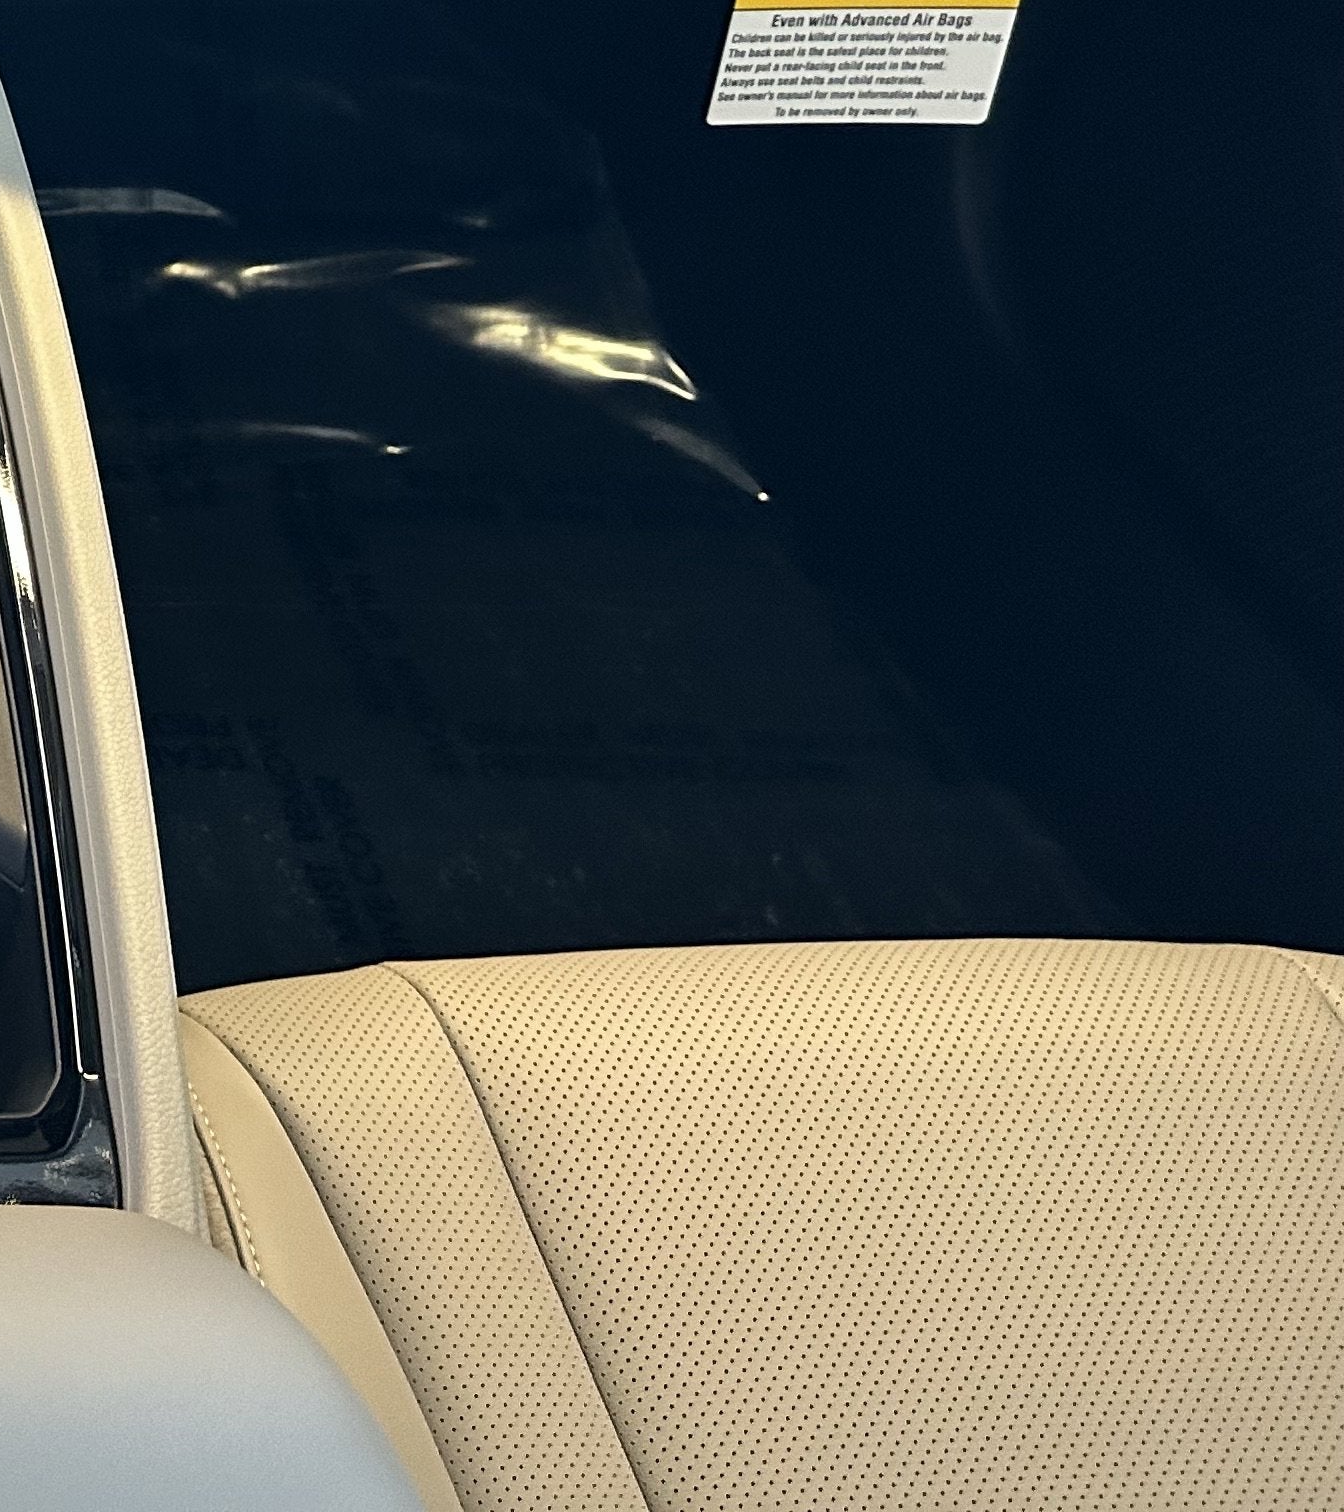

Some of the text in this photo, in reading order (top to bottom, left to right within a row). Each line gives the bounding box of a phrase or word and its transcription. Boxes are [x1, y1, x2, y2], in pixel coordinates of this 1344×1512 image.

[771, 12, 973, 29] Even with Advanced Air Bags
[732, 33, 772, 43] Children
[774, 34, 792, 42] can
[794, 32, 806, 42] be
[808, 32, 837, 42] killed
[850, 32, 894, 43] seriously
[897, 32, 932, 43] injured
[934, 32, 946, 43] by
[948, 32, 964, 41] the
[966, 32, 981, 42] air
[729, 48, 746, 58] The
[748, 48, 771, 57] back
[773, 47, 795, 57] seat
[796, 47, 806, 56] is
[808, 47, 825, 56] the
[858, 47, 887, 57] place
[888, 47, 903, 56] for
[725, 63, 753, 73] Never
[754, 63, 772, 74] put
[838, 61, 864, 70] child
[864, 61, 887, 70] seat
[888, 61, 899, 70] in
[900, 61, 917, 70] the
[720, 77, 755, 88] Always
[777, 76, 799, 86] seat
[800, 76, 825, 85] belts
[827, 75, 847, 85] and
[848, 75, 873, 85] child
[717, 92, 736, 102] See
[776, 90, 813, 100] manual
[814, 90, 829, 99] for
[915, 90, 943, 100] about
[944, 90, 959, 100] air
[775, 107, 787, 117] To
[788, 107, 801, 116] be
[802, 106, 847, 116] removed
[848, 107, 859, 117] by
